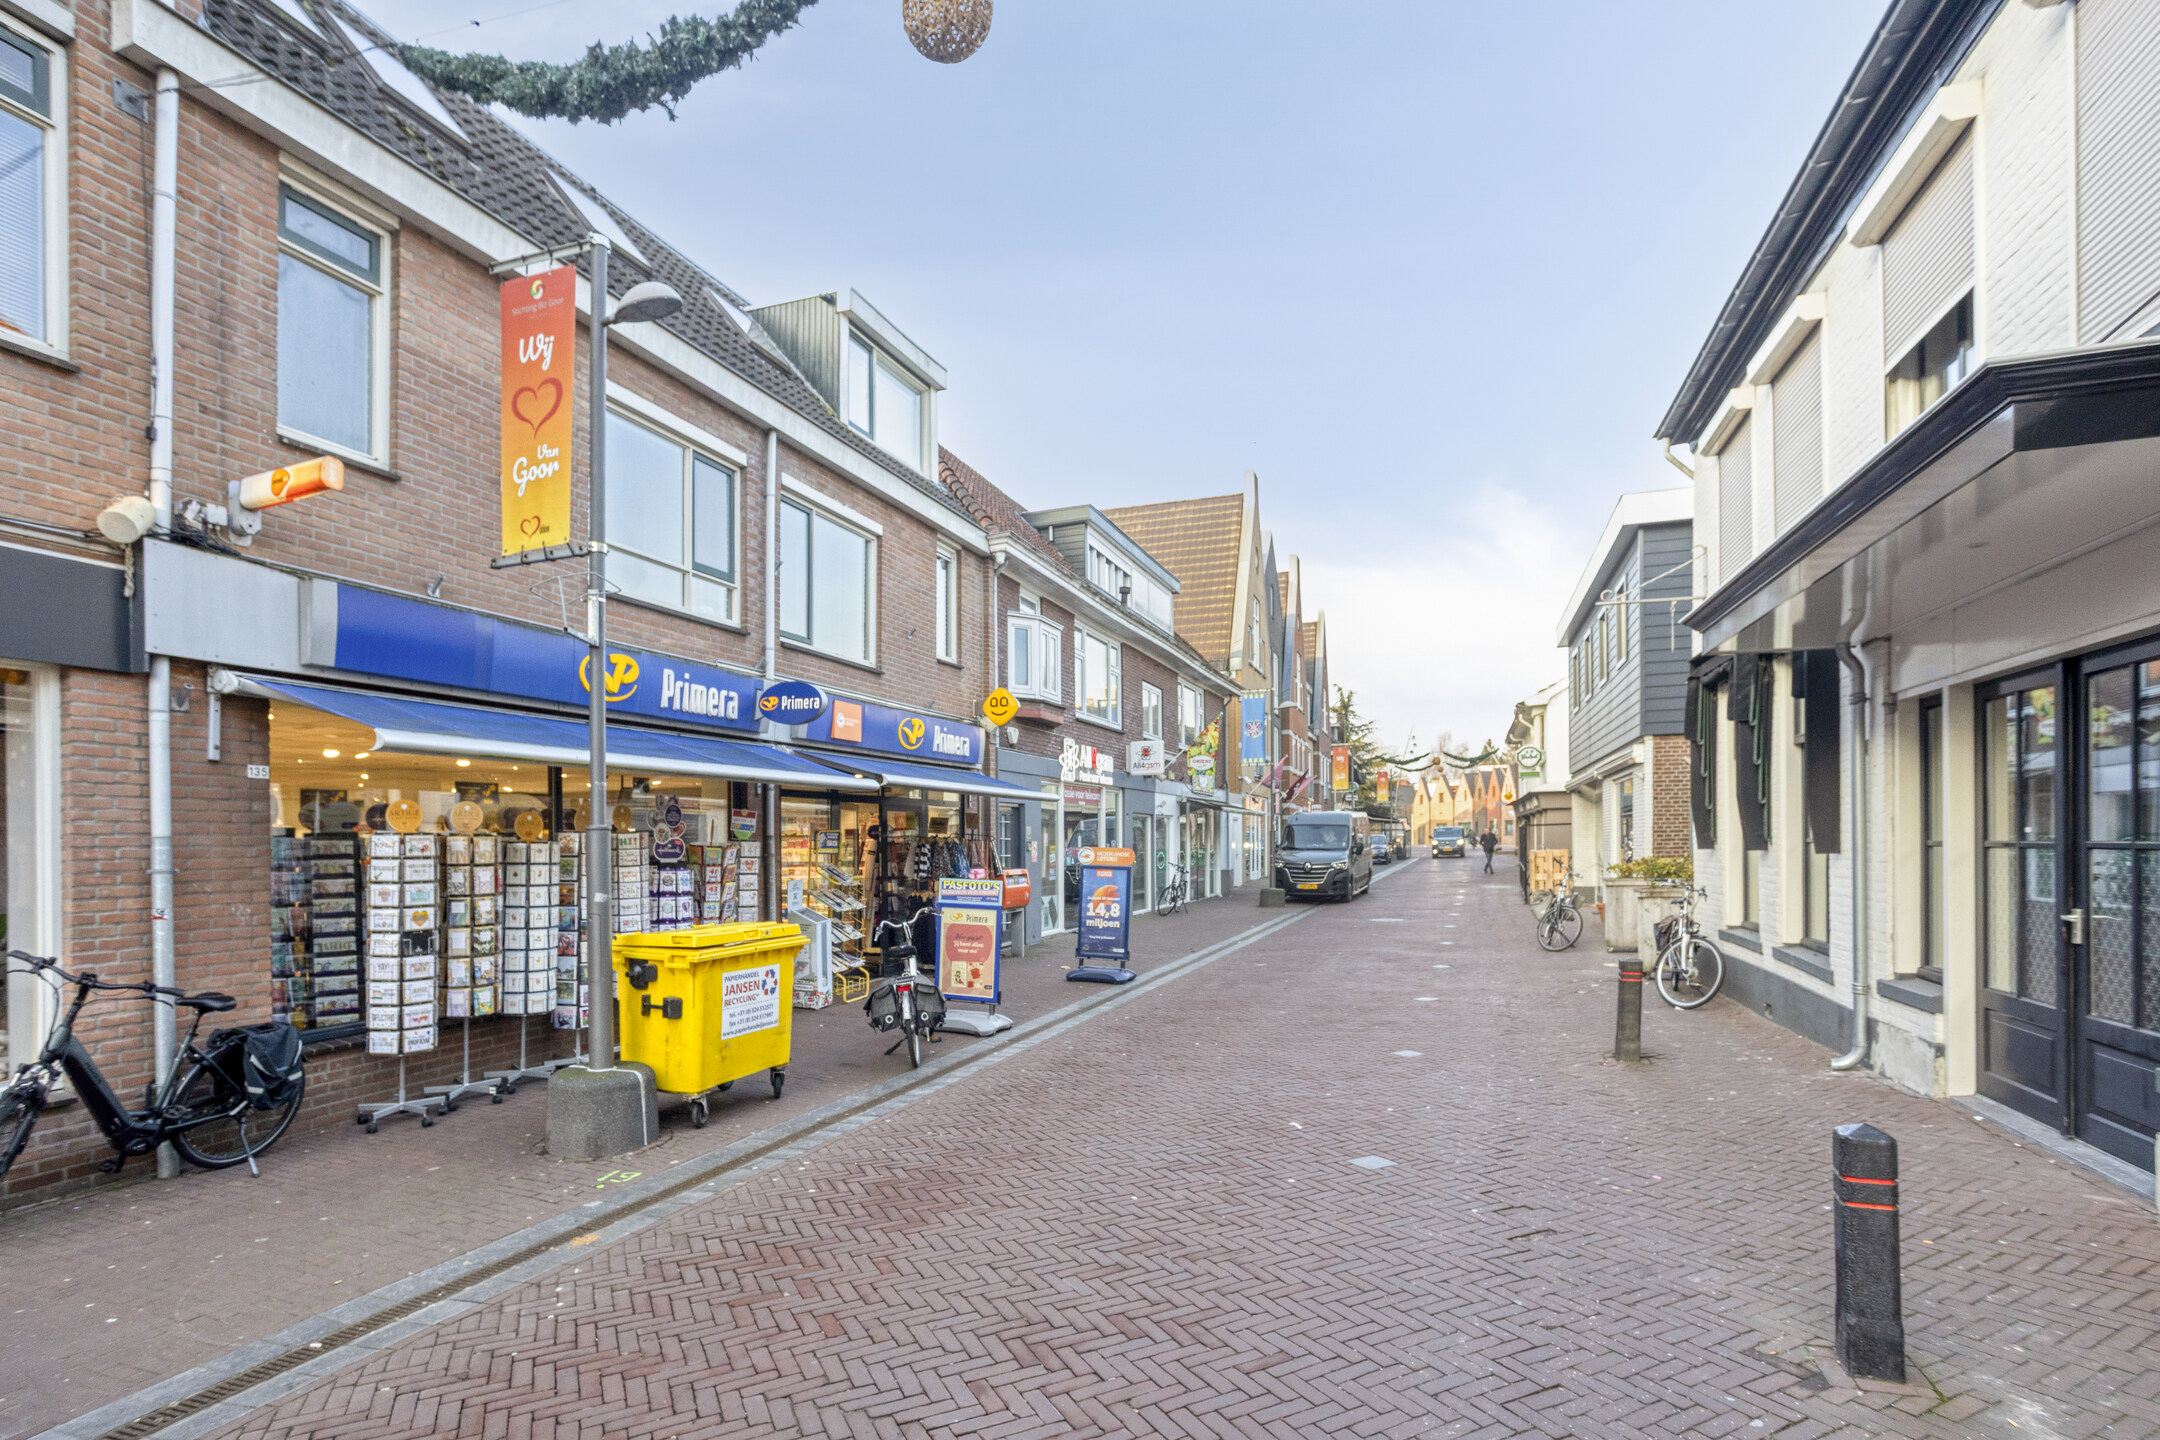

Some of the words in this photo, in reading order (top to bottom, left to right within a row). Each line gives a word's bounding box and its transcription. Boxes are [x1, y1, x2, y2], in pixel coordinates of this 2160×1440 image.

[519, 333, 555, 371] Wij
[537, 443, 559, 459] Van
[513, 457, 559, 497] Goor
[660, 668, 739, 720] Primera
[781, 695, 820, 711] Primera
[932, 724, 970, 757] Primera
[249, 766, 268, 777] 135
[1133, 762, 1160, 770] All4gsm
[943, 880, 1000, 891] PASFOTO'S
[1086, 902, 1121, 919] 14,8
[966, 914, 988, 924] Primera
[1085, 918, 1120, 929] miljoen
[724, 971, 760, 982] PAPIERHANDEL
[724, 979, 760, 997] JANSEN
